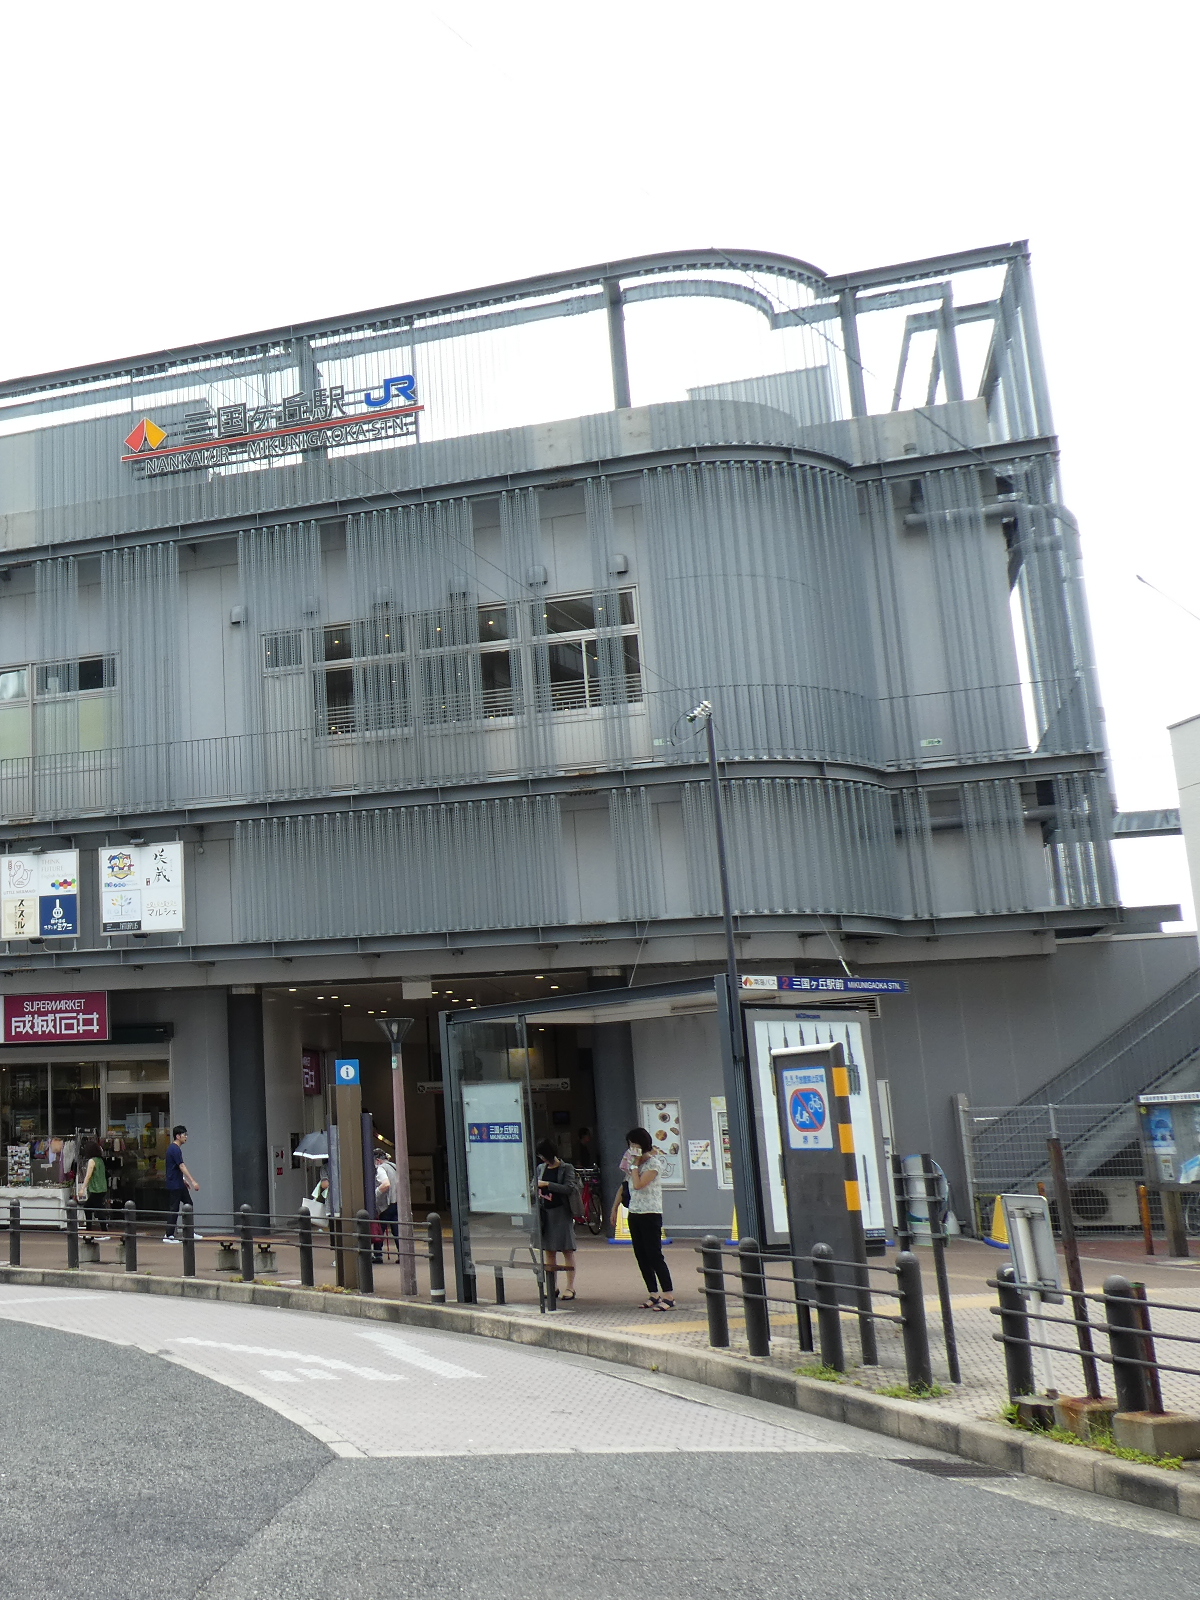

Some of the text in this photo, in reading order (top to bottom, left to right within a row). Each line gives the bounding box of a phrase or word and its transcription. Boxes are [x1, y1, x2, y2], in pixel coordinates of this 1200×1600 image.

[365, 374, 418, 408] JR
[247, 422, 367, 460] MIKUNIGAOKA
[781, 977, 790, 989] 2
[792, 977, 845, 991] 三国ヶ丘駅前
[847, 981, 888, 989] MIKUNIGAOKA
[23, 999, 86, 1012] SUPERMARKET
[11, 1011, 100, 1036] 成城石井
[481, 1127, 488, 1140] 2
